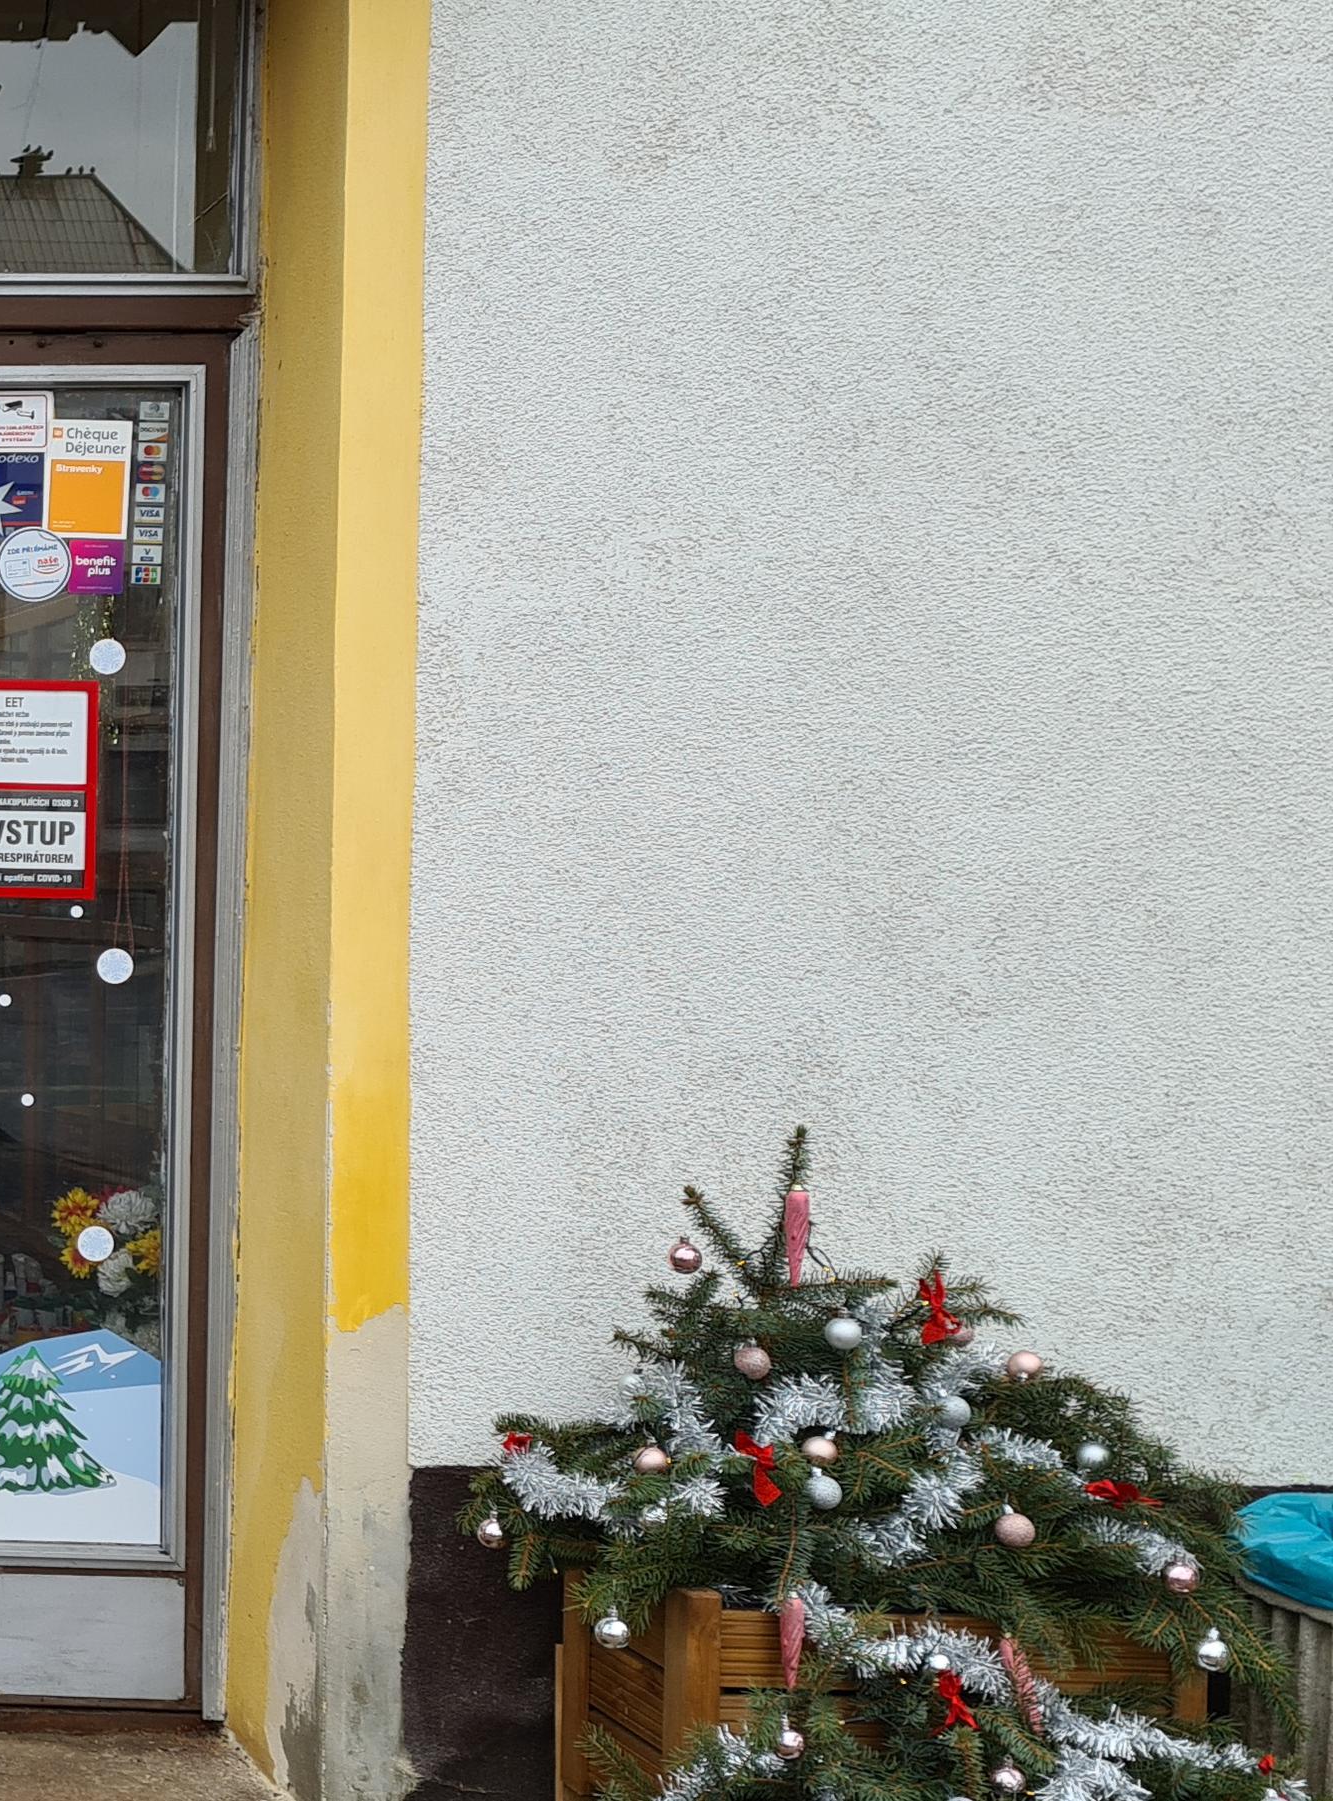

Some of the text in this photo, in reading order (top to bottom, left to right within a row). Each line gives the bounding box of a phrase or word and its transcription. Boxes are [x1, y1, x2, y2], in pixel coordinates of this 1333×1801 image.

[65, 441, 126, 456] Déjeuner
[56, 464, 103, 475] Stravenky
[140, 509, 160, 517] VISA
[139, 529, 158, 537] VISA
[76, 555, 117, 566] benefit
[87, 566, 111, 577] plus
[5, 697, 24, 708] EET
[73, 799, 79, 807] 2
[36, 874, 73, 883] COVID-19
